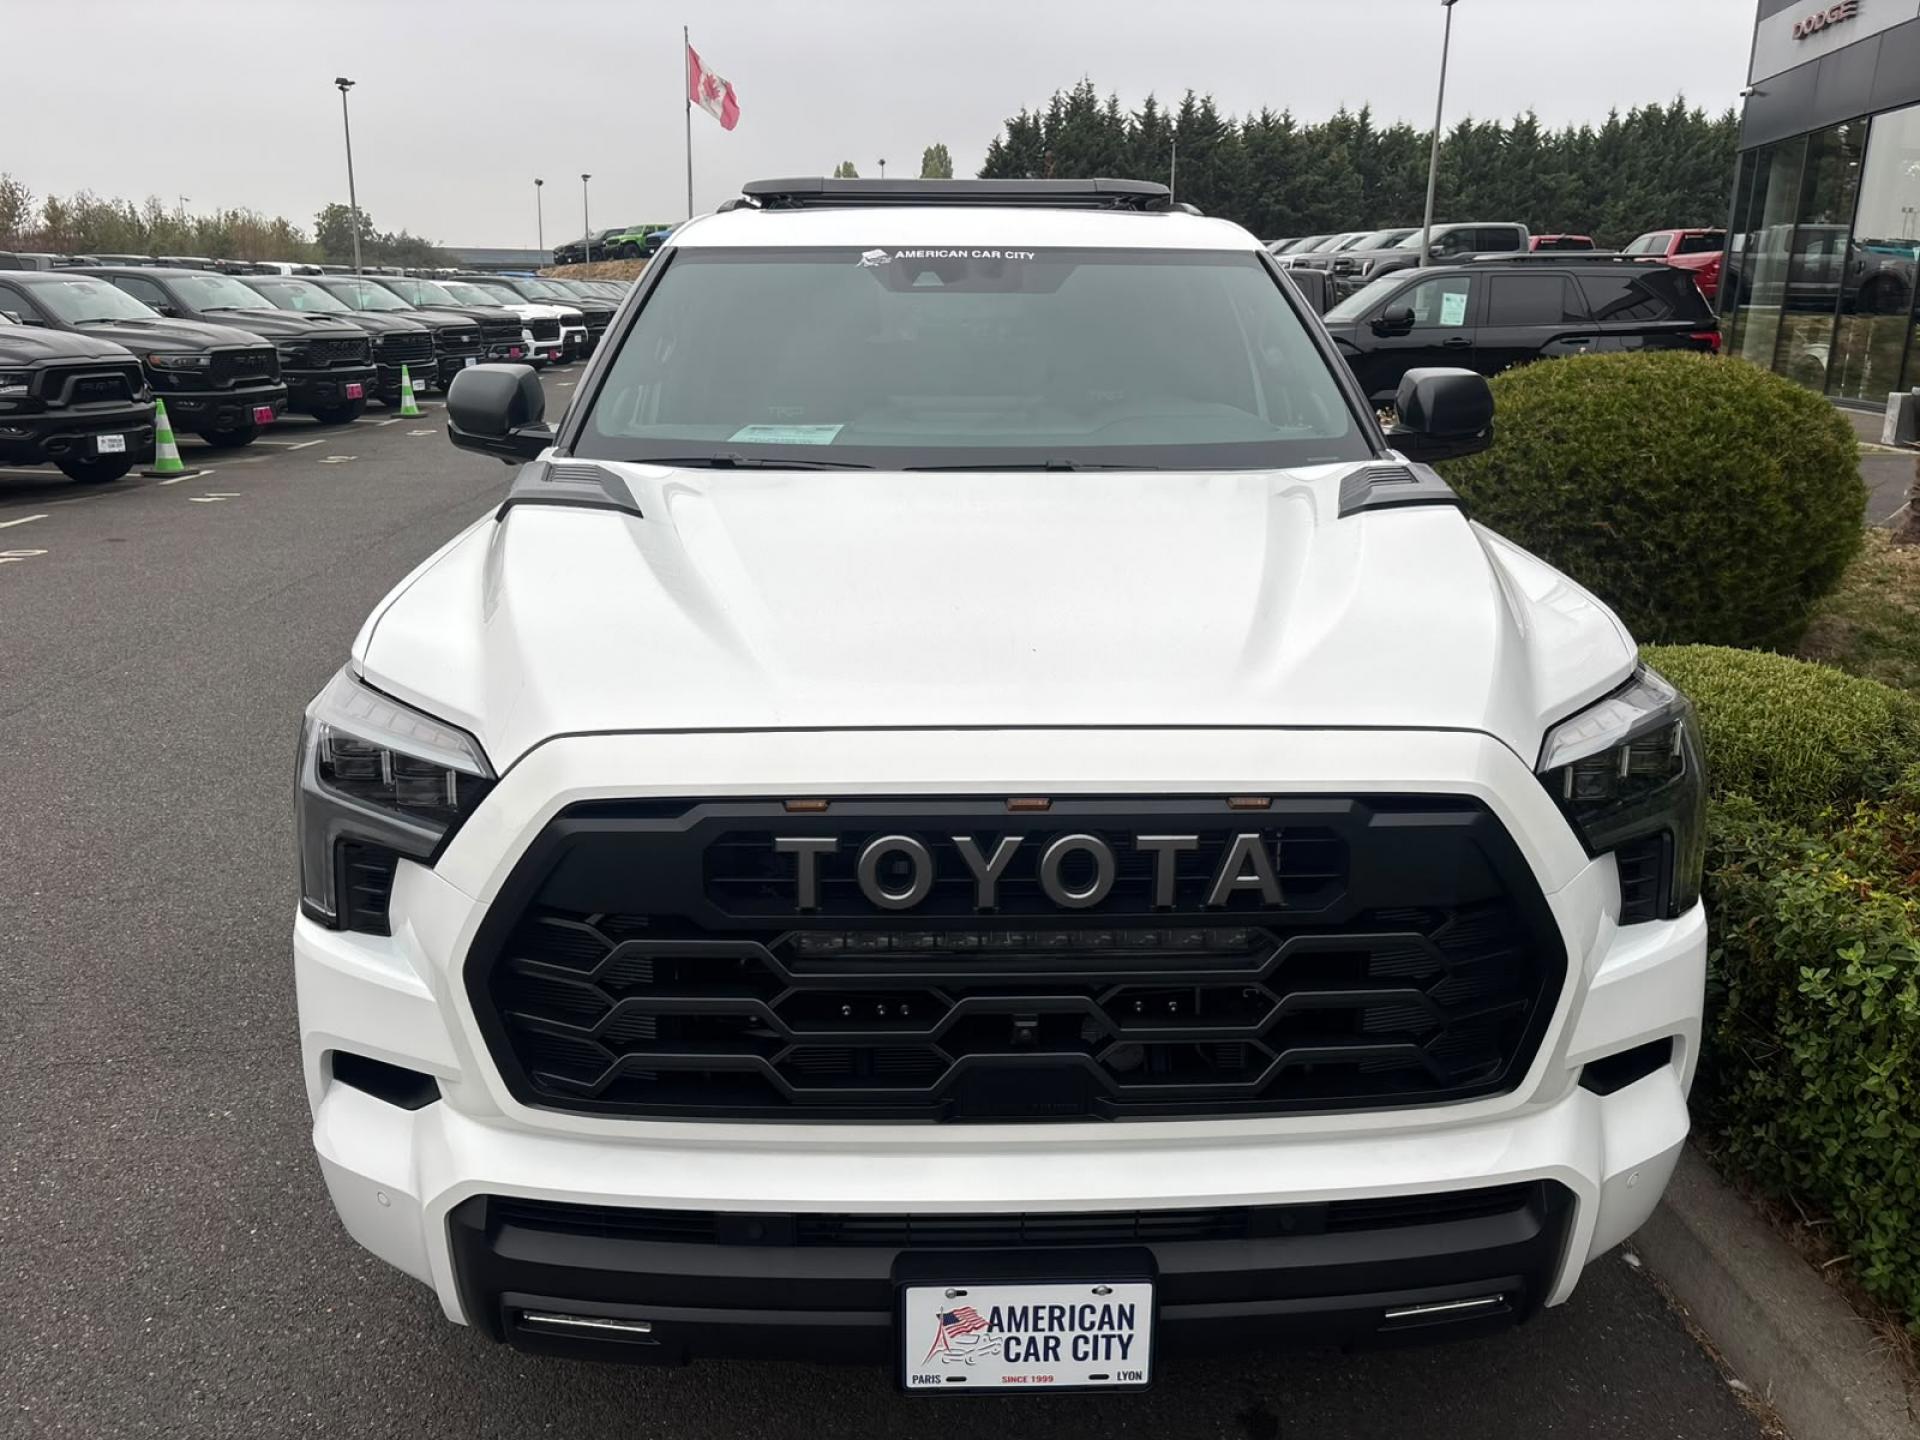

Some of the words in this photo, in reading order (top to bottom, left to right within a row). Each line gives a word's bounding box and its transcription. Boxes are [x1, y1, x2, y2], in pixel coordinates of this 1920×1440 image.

[1792, 0, 1857, 39] DODGE
[895, 250, 967, 258] AMERICAN
[971, 250, 1000, 259] CAR
[1005, 251, 1035, 260] CITY
[775, 834, 1284, 910] TOYOTA
[987, 1304, 1134, 1333] AMERICAN
[1003, 1335, 1061, 1363] CAR
[1071, 1334, 1134, 1361] CITY
[912, 1375, 941, 1385] PARIS
[1032, 1375, 1054, 1383] 1999
[1117, 1371, 1142, 1381] LYON
